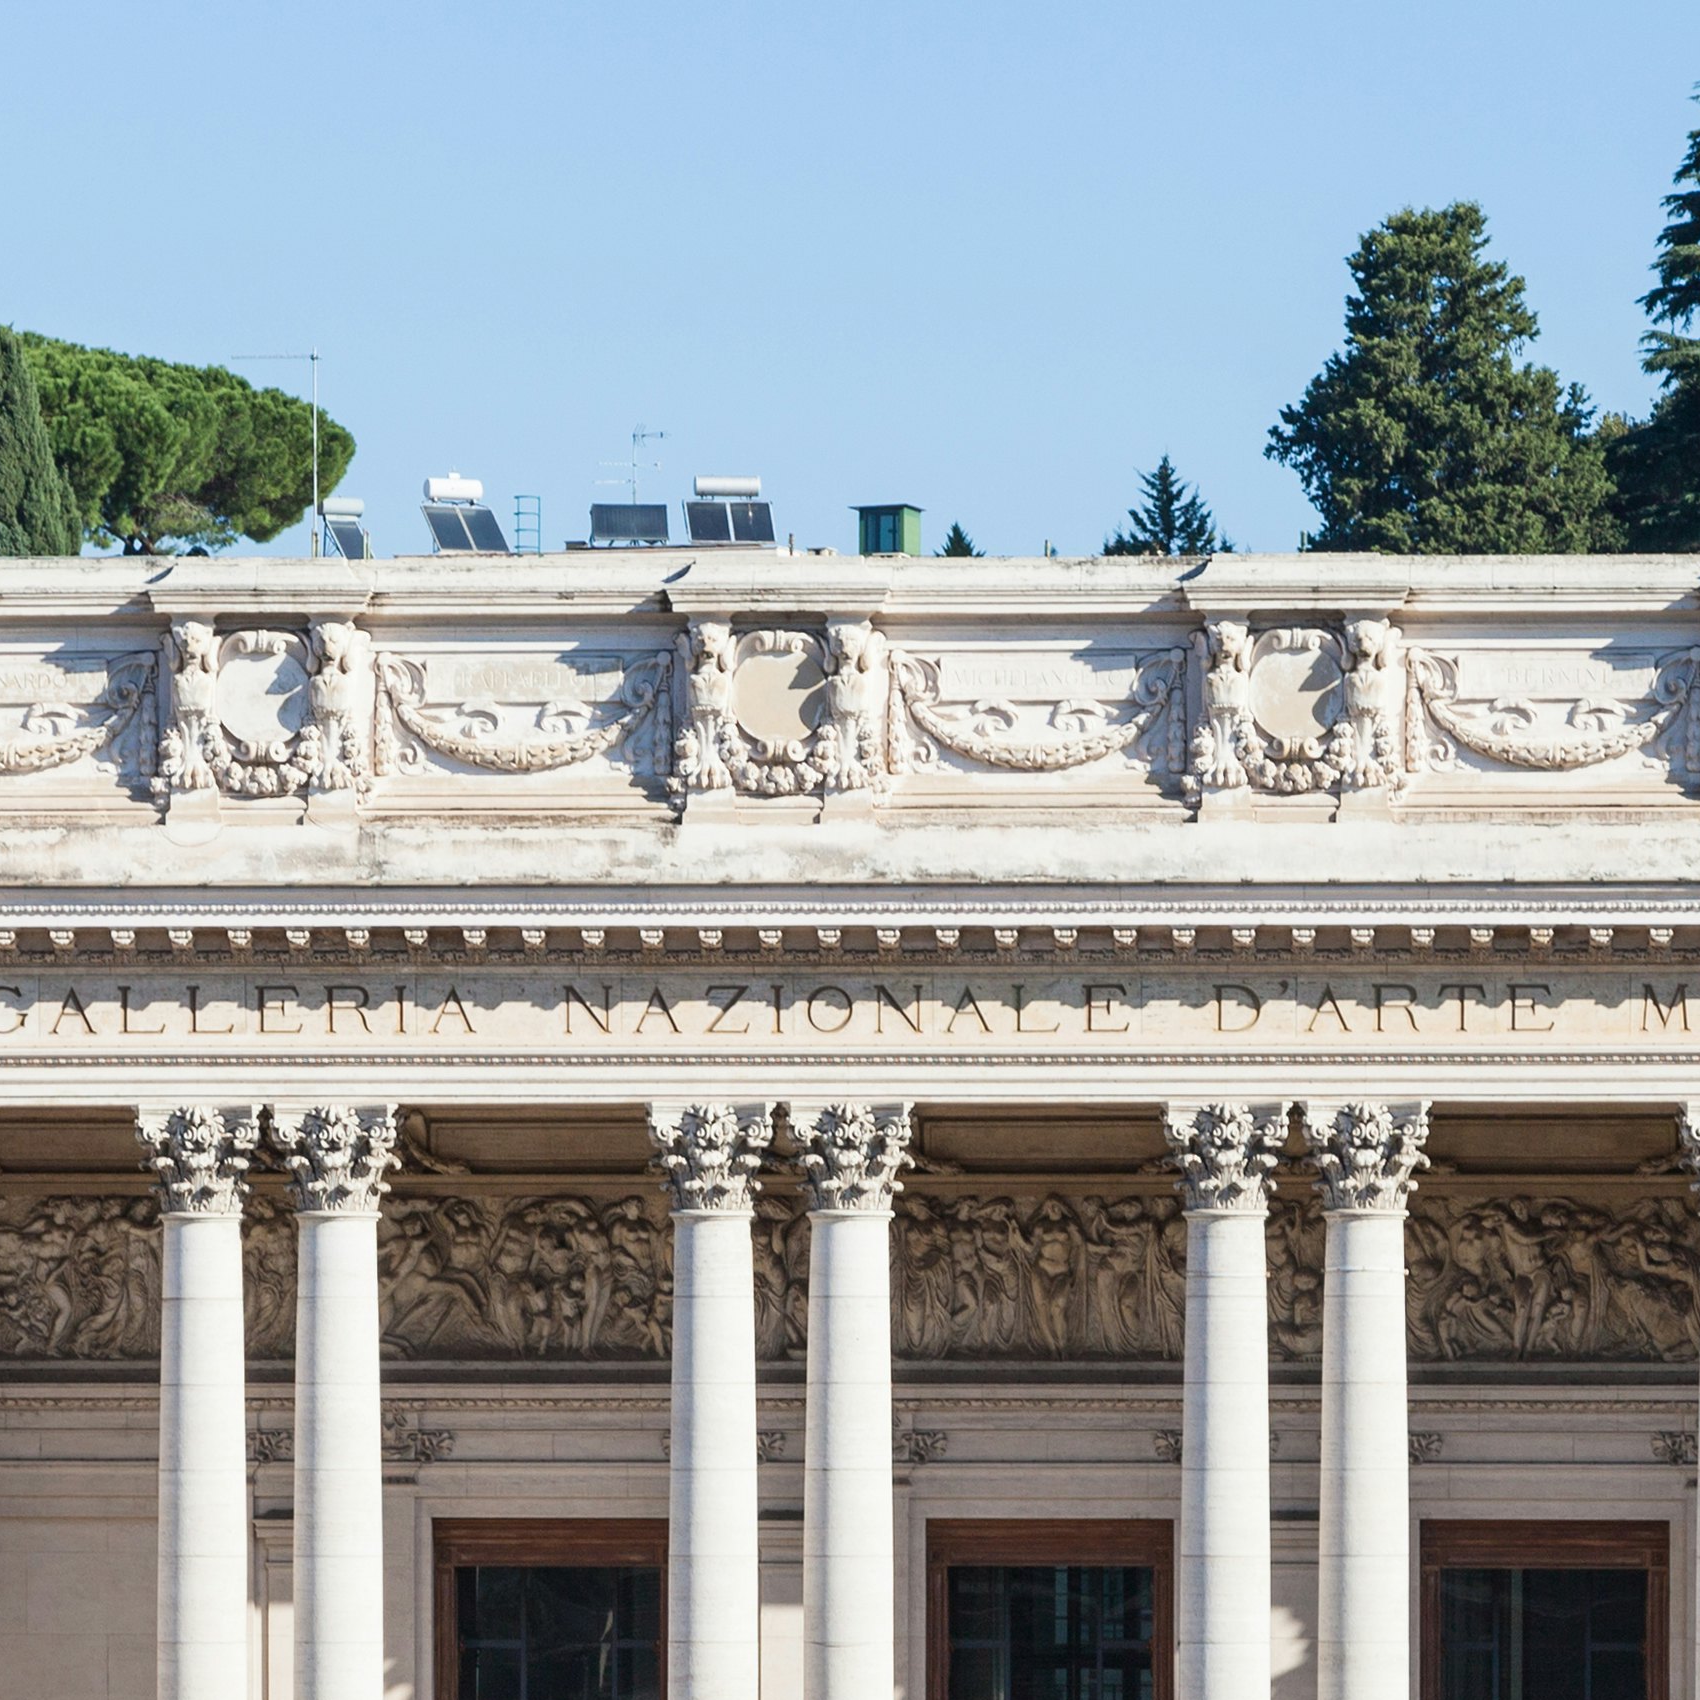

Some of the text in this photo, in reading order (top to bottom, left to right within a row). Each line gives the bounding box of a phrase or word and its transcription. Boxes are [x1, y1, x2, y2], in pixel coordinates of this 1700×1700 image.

[953, 669, 1124, 687] MICHELANGELO
[1506, 667, 1609, 685] BERNINI
[562, 984, 1131, 1035] NAZIONALE
[1211, 983, 1555, 1034] D'ARTE
